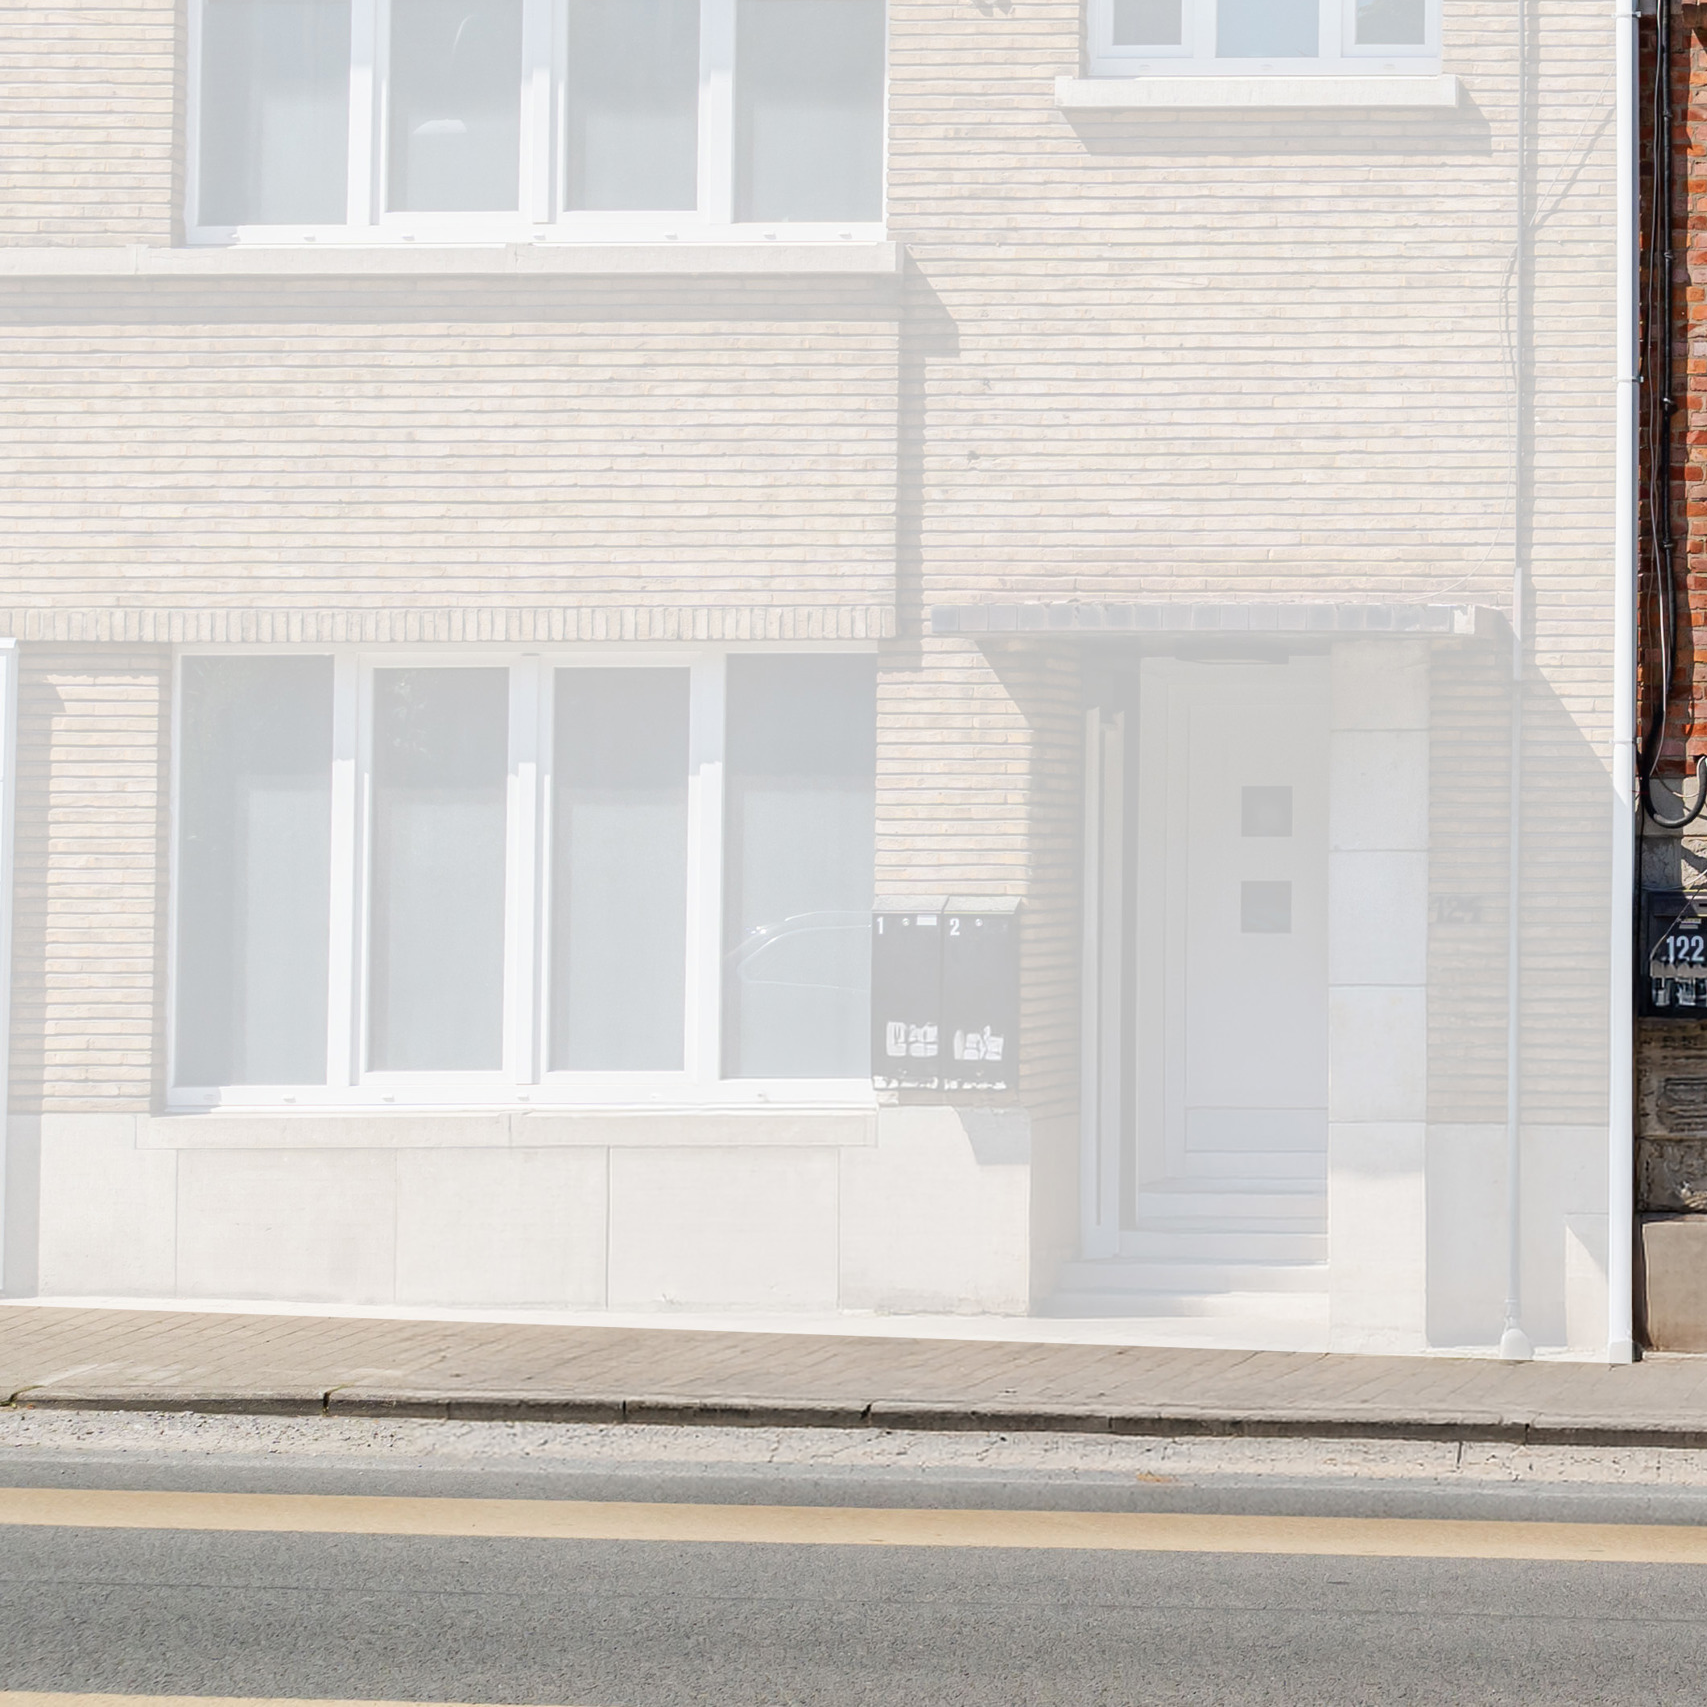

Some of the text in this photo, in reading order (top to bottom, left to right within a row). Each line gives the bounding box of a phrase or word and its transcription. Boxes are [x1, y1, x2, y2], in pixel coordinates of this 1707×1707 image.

[876, 916, 884, 935] 1
[949, 917, 960, 936] 2
[1666, 935, 1705, 962] 122
